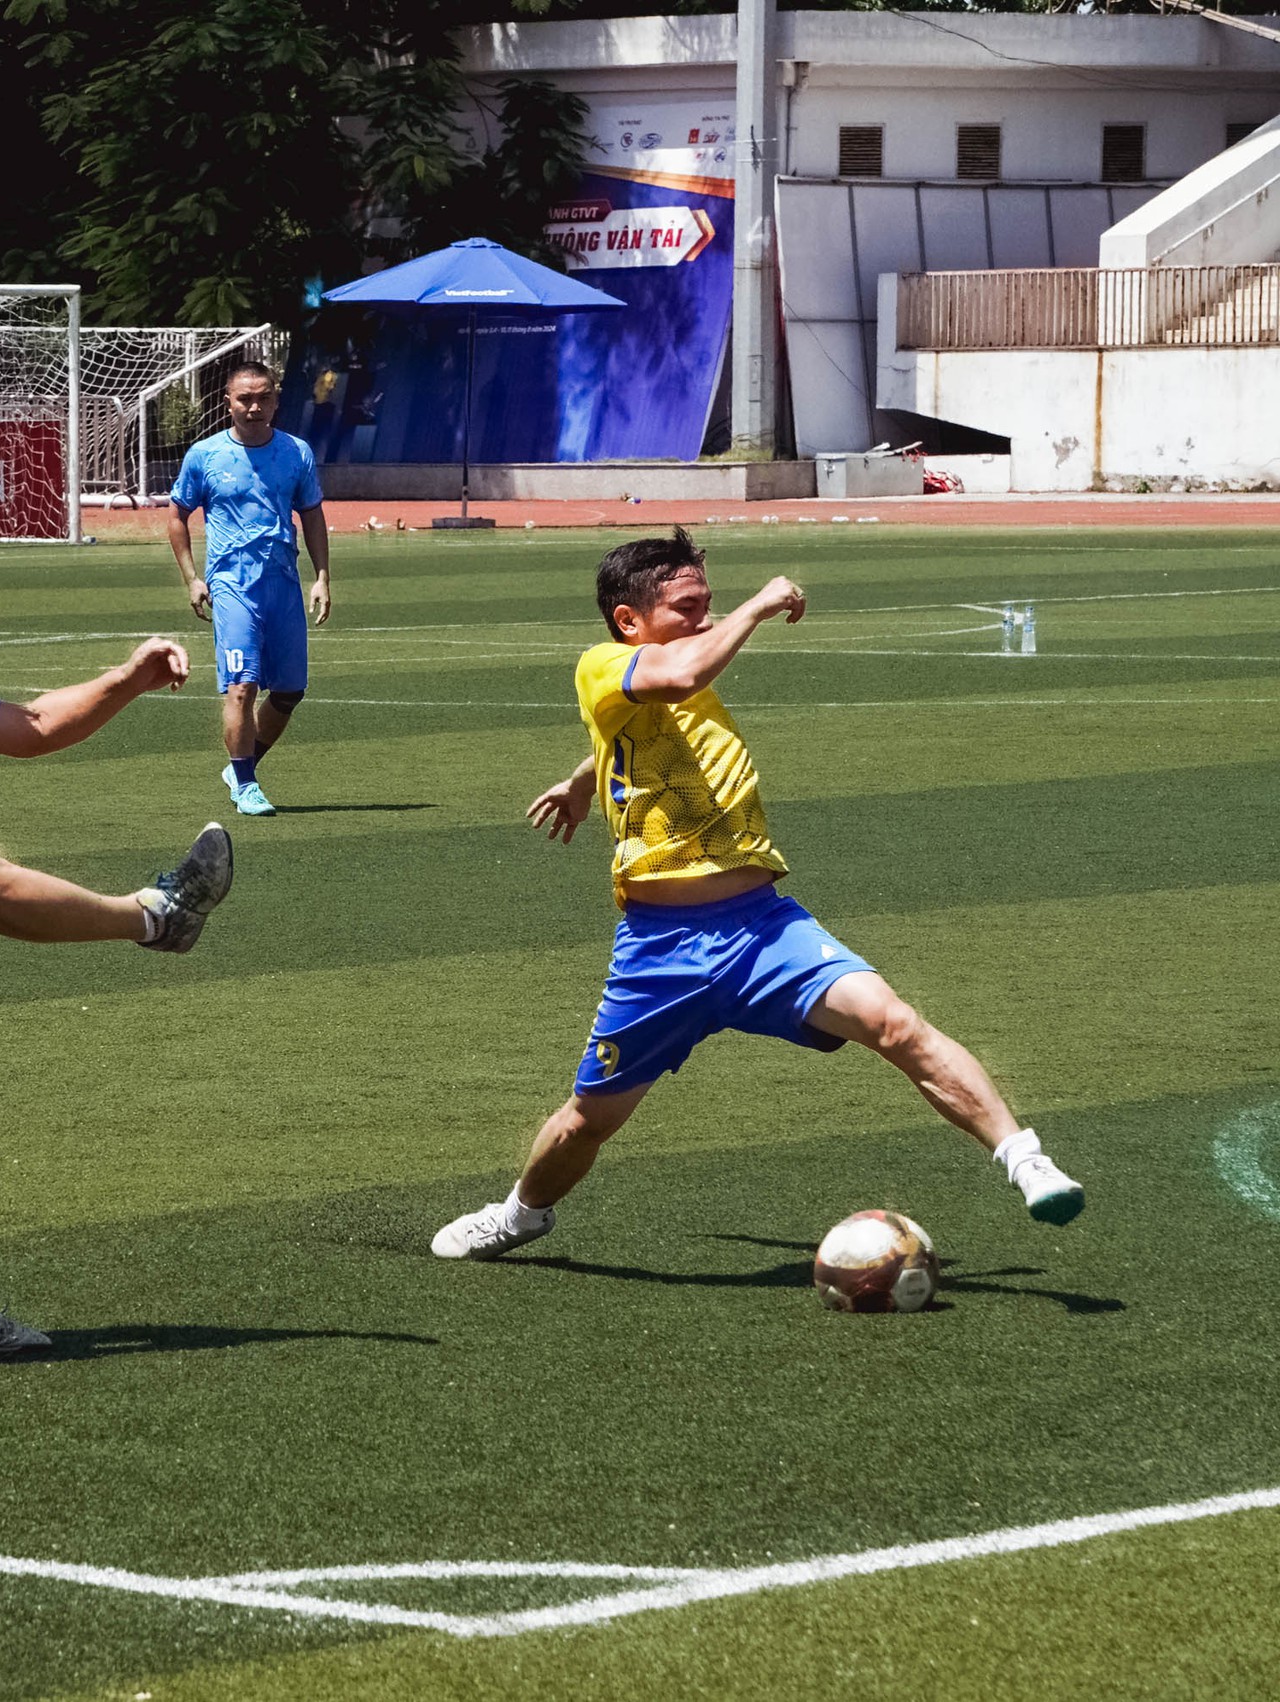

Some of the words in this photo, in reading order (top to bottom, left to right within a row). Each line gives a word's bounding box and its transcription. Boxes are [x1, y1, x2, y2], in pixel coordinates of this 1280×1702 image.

[571, 206, 599, 219] GTVT
[606, 225, 643, 255] VẬN
[224, 649, 244, 673] 10
[596, 1040, 620, 1077] 9
